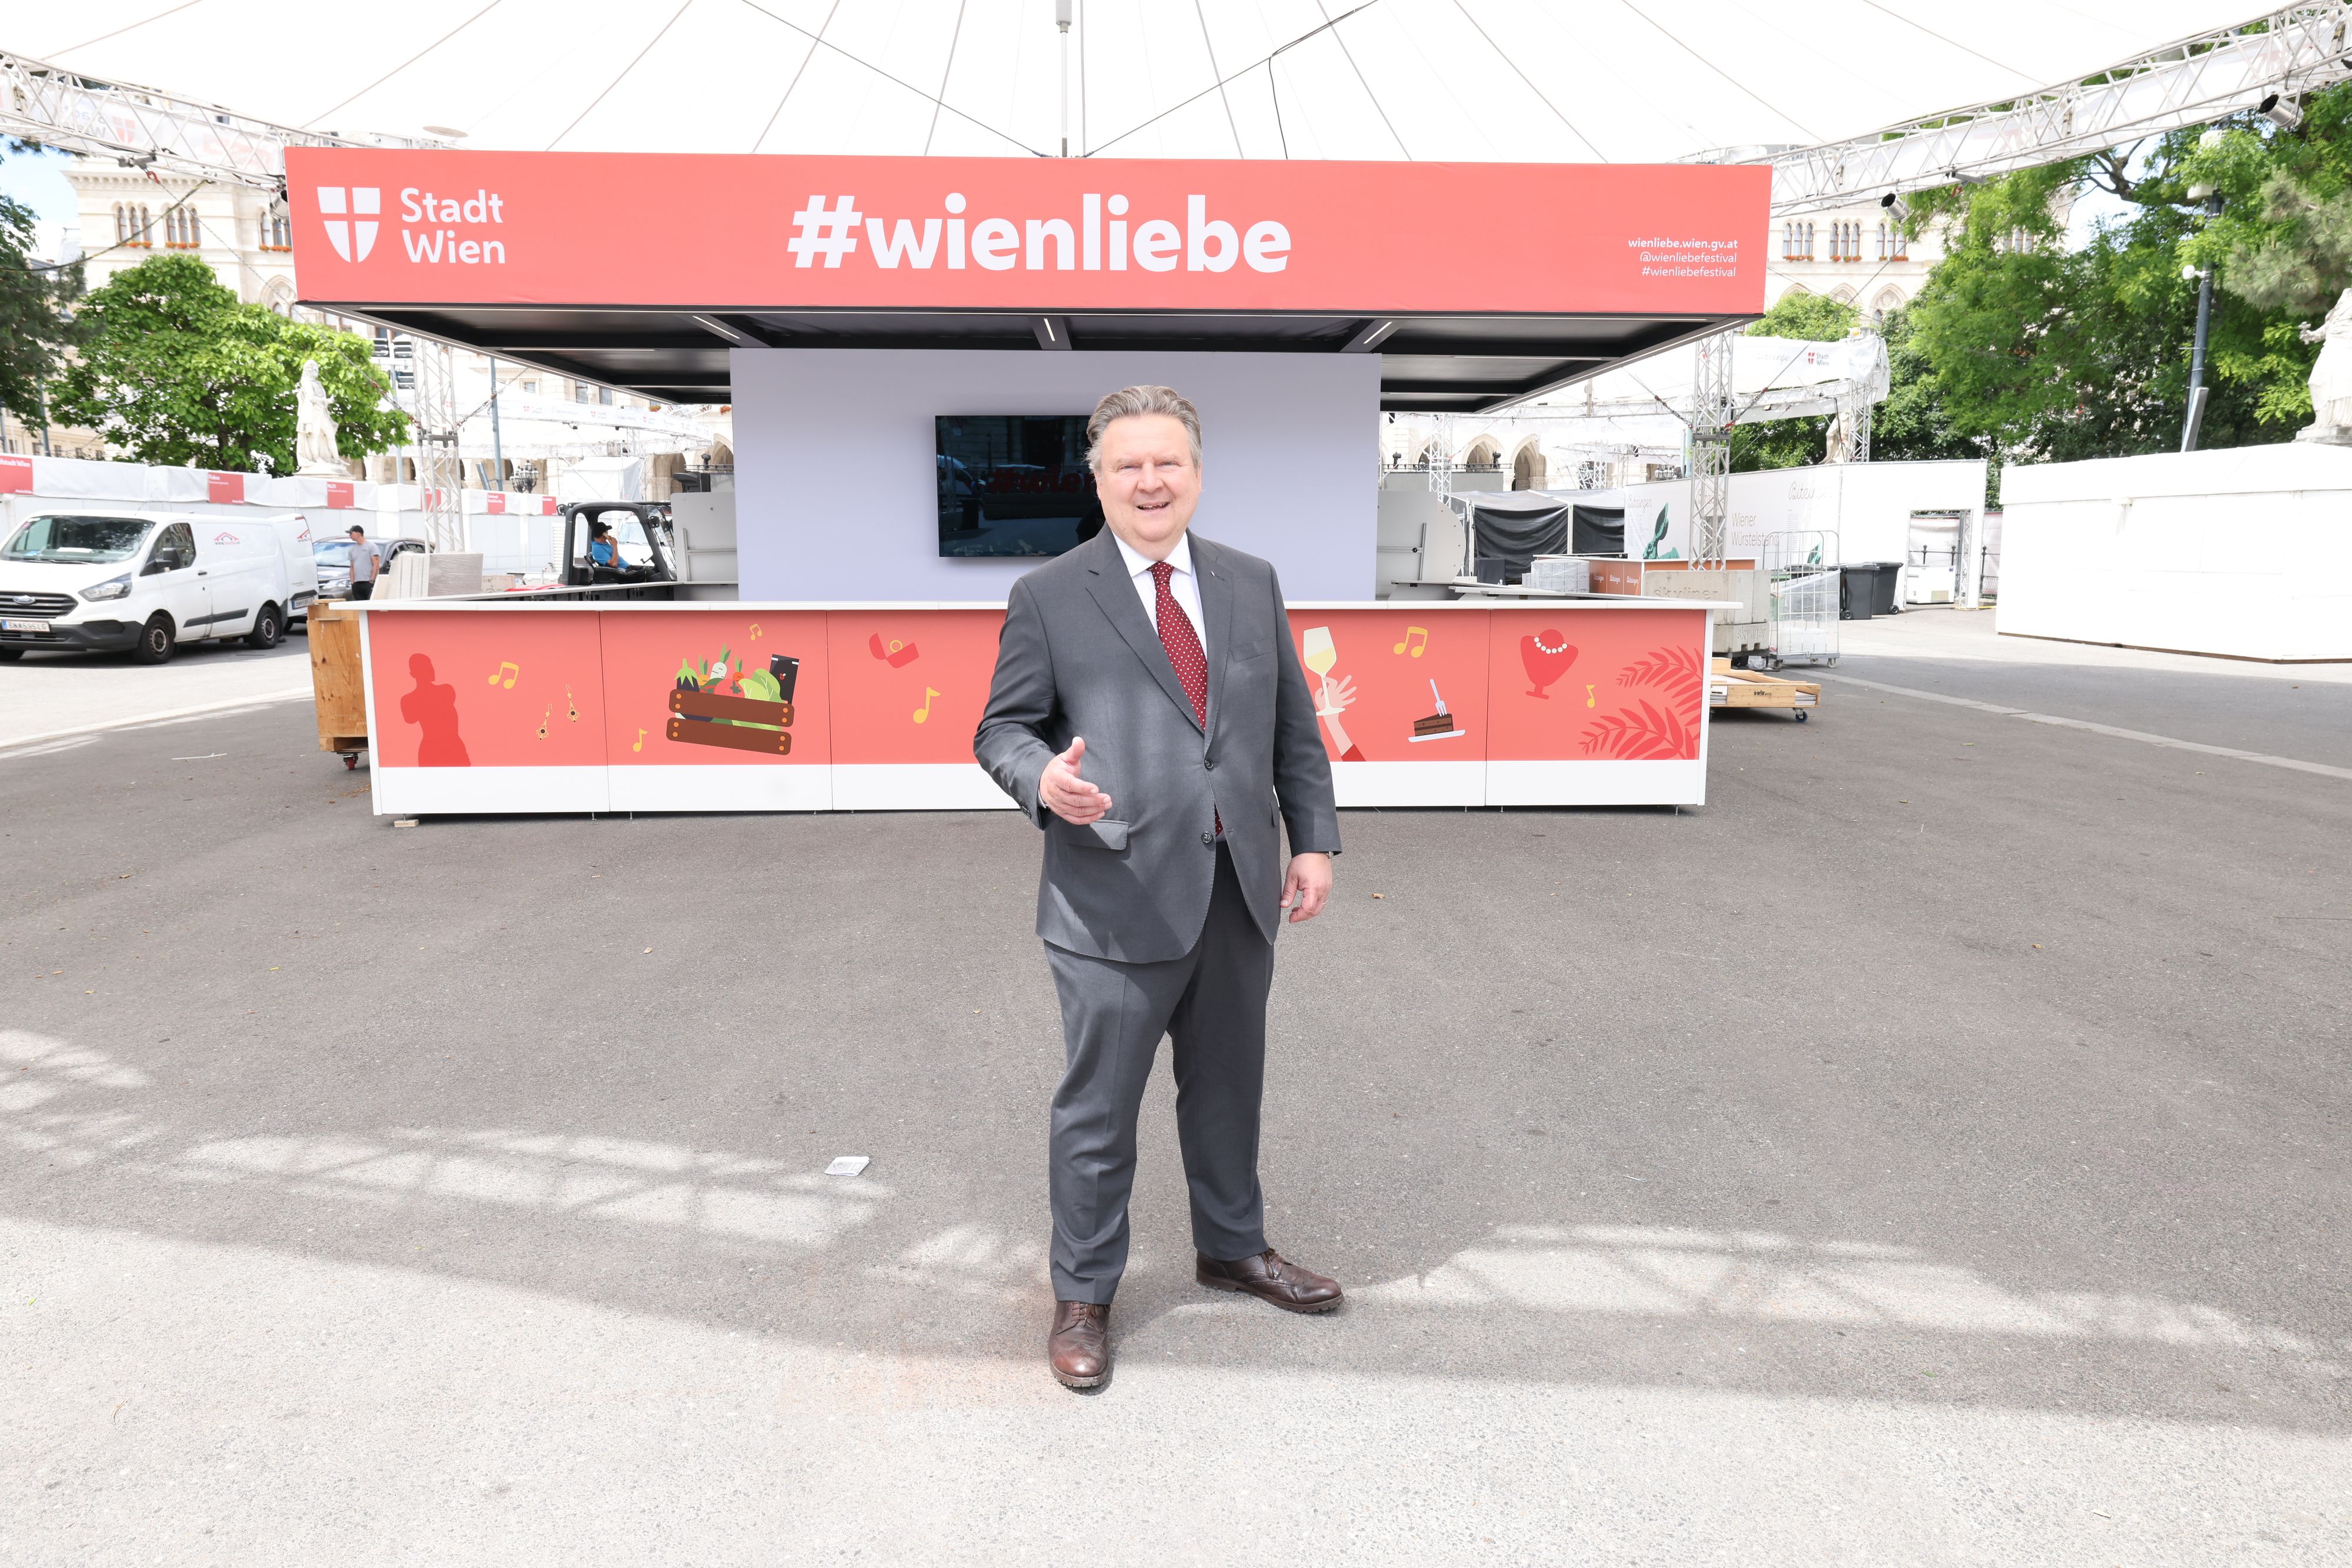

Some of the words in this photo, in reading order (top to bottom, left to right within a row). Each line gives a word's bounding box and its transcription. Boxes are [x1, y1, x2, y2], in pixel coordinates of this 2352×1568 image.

[400, 187, 504, 224] Stadt
[786, 192, 1292, 273] #wienliebe
[402, 229, 506, 264] Wien
[1628, 237, 1738, 252] wienliebe.wien.gv.at
[1639, 251, 1738, 263] @wienliebefestival
[1641, 266, 1736, 278] #wienliebefestival
[1732, 513, 1757, 527] Wiener
[1731, 531, 1780, 547] Würstelstand
[1653, 587, 1719, 600] skyliner
[1737, 626, 1767, 641] skyliner
